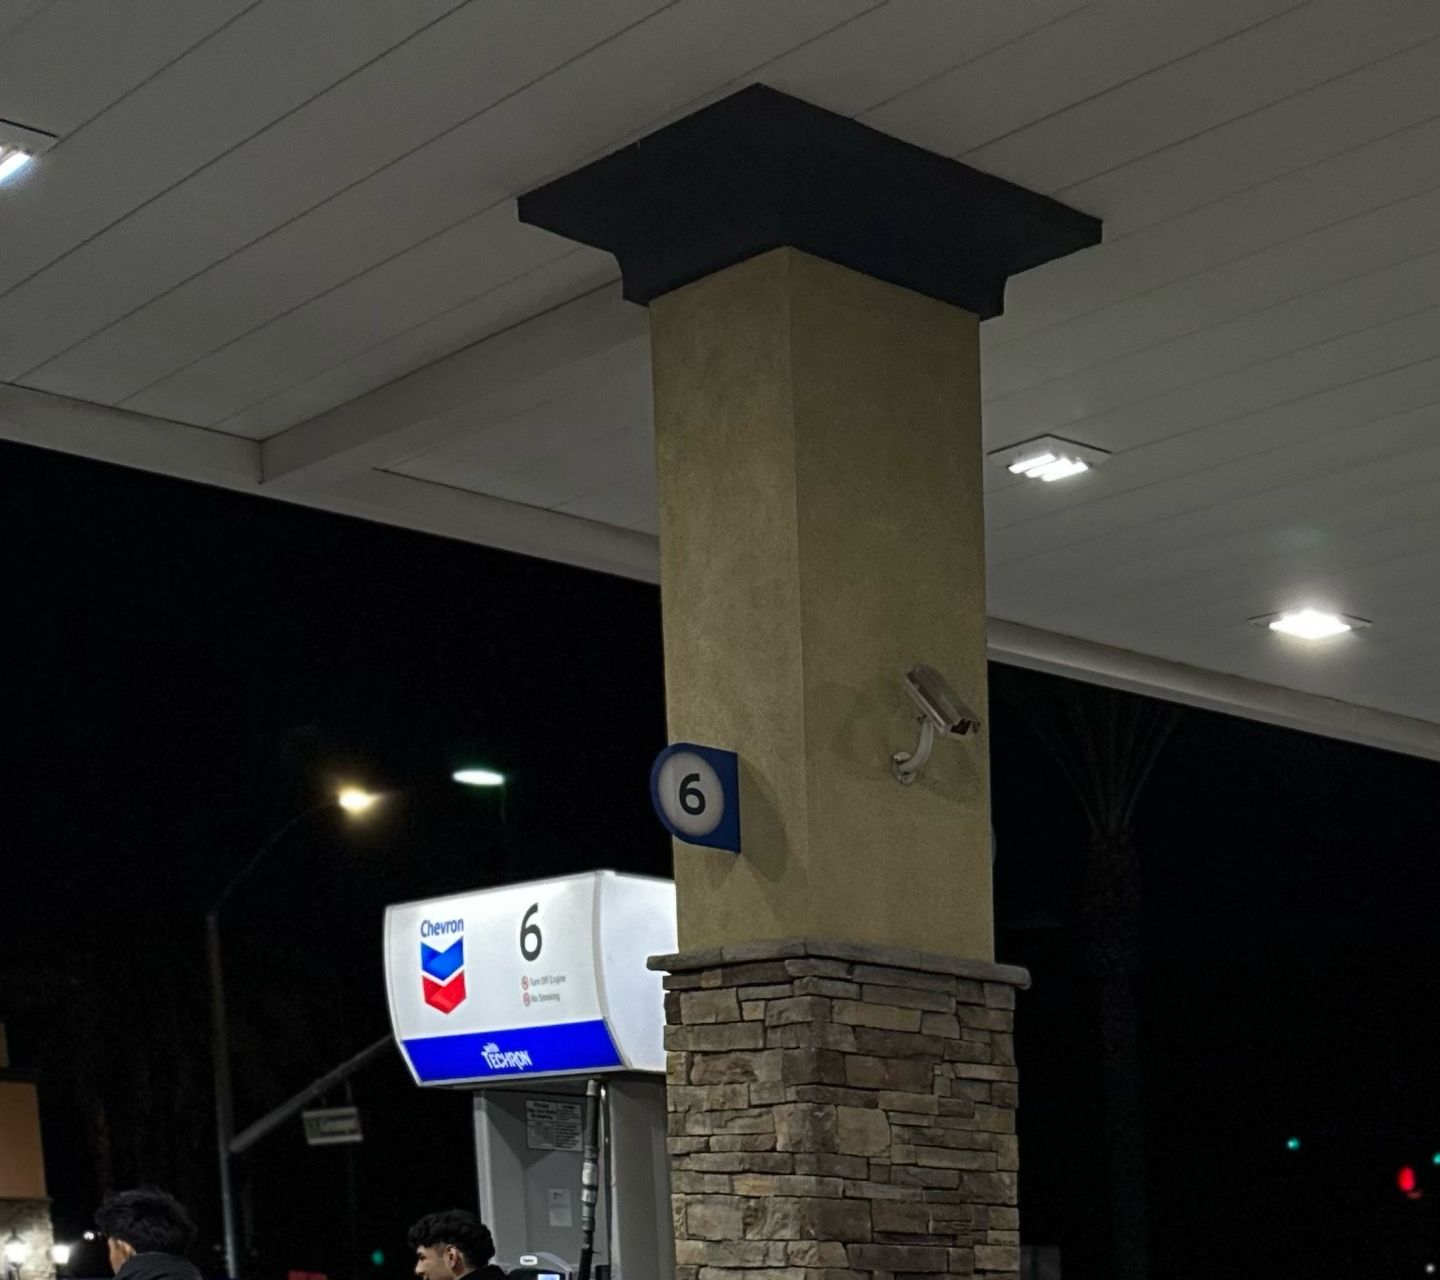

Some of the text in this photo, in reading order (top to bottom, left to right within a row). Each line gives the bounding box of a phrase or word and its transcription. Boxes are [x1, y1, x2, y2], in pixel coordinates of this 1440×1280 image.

[678, 773, 707, 816] 6
[420, 918, 464, 937] Chevron
[520, 902, 543, 962] 6
[481, 1050, 533, 1070] TECHRON
